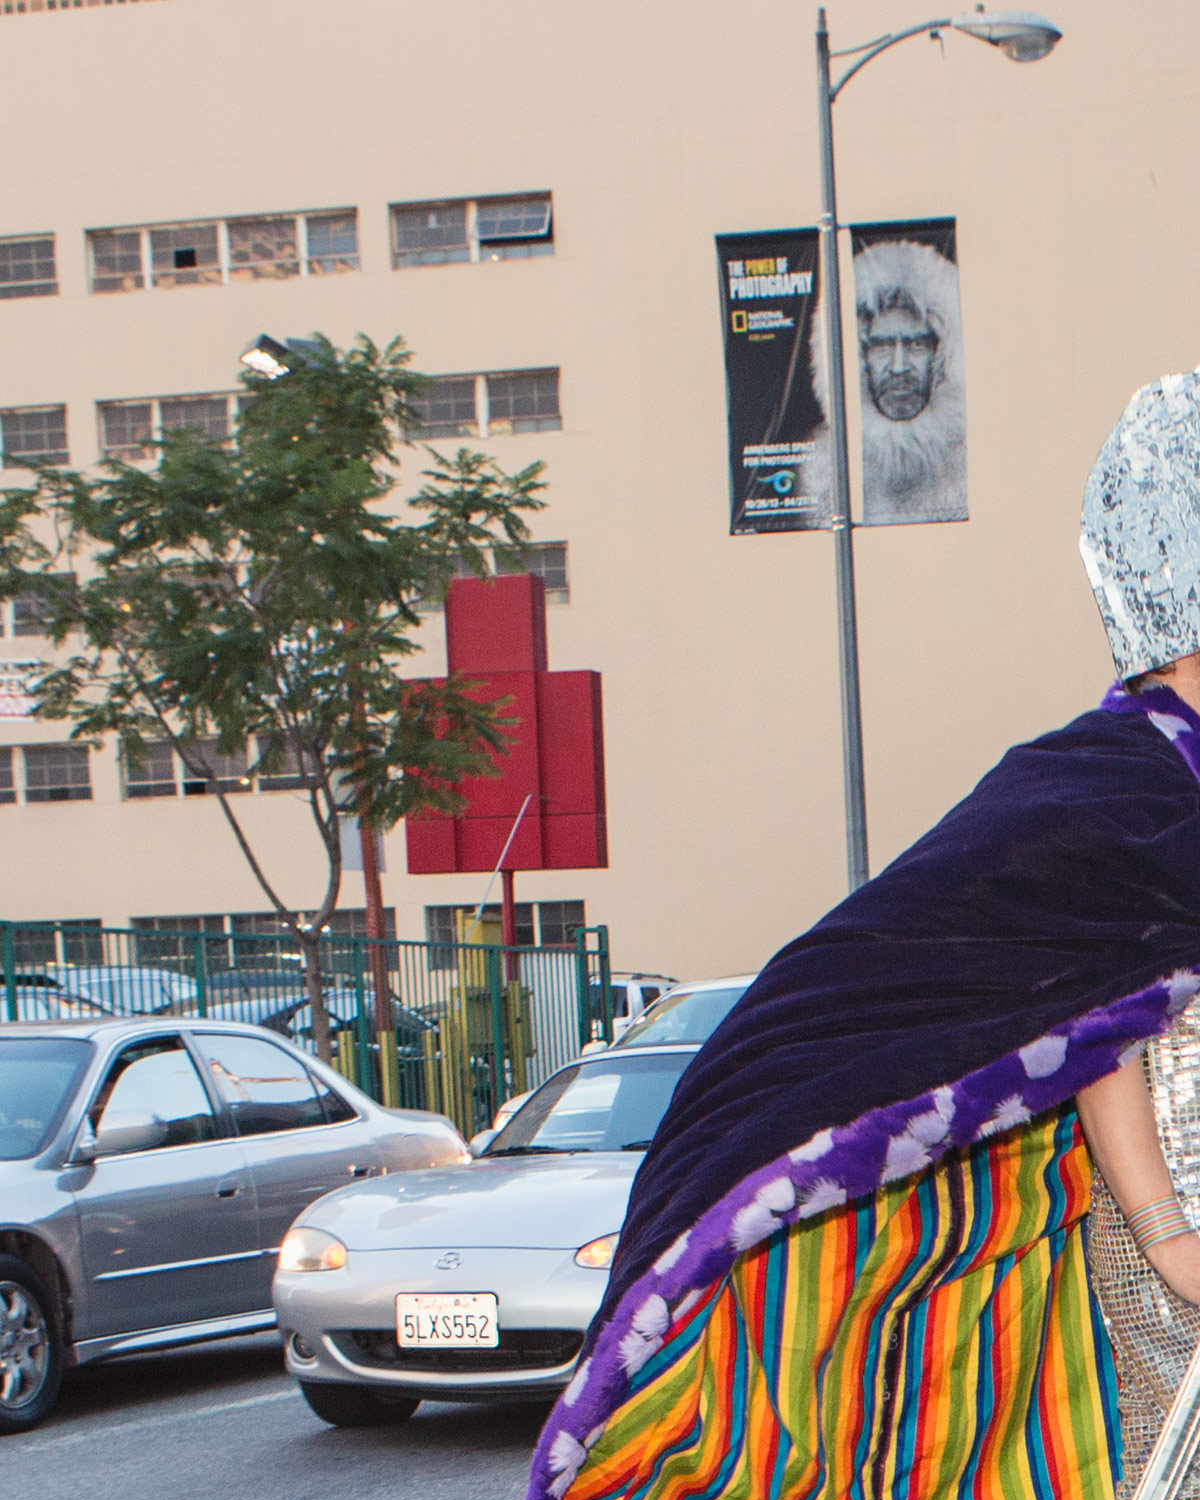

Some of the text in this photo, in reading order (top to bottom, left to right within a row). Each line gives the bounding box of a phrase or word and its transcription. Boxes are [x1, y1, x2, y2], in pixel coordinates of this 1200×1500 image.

[728, 261, 744, 277] THE
[730, 271, 813, 300] PHOTOGRAPHY
[404, 1315, 490, 1338] 5LXS552
